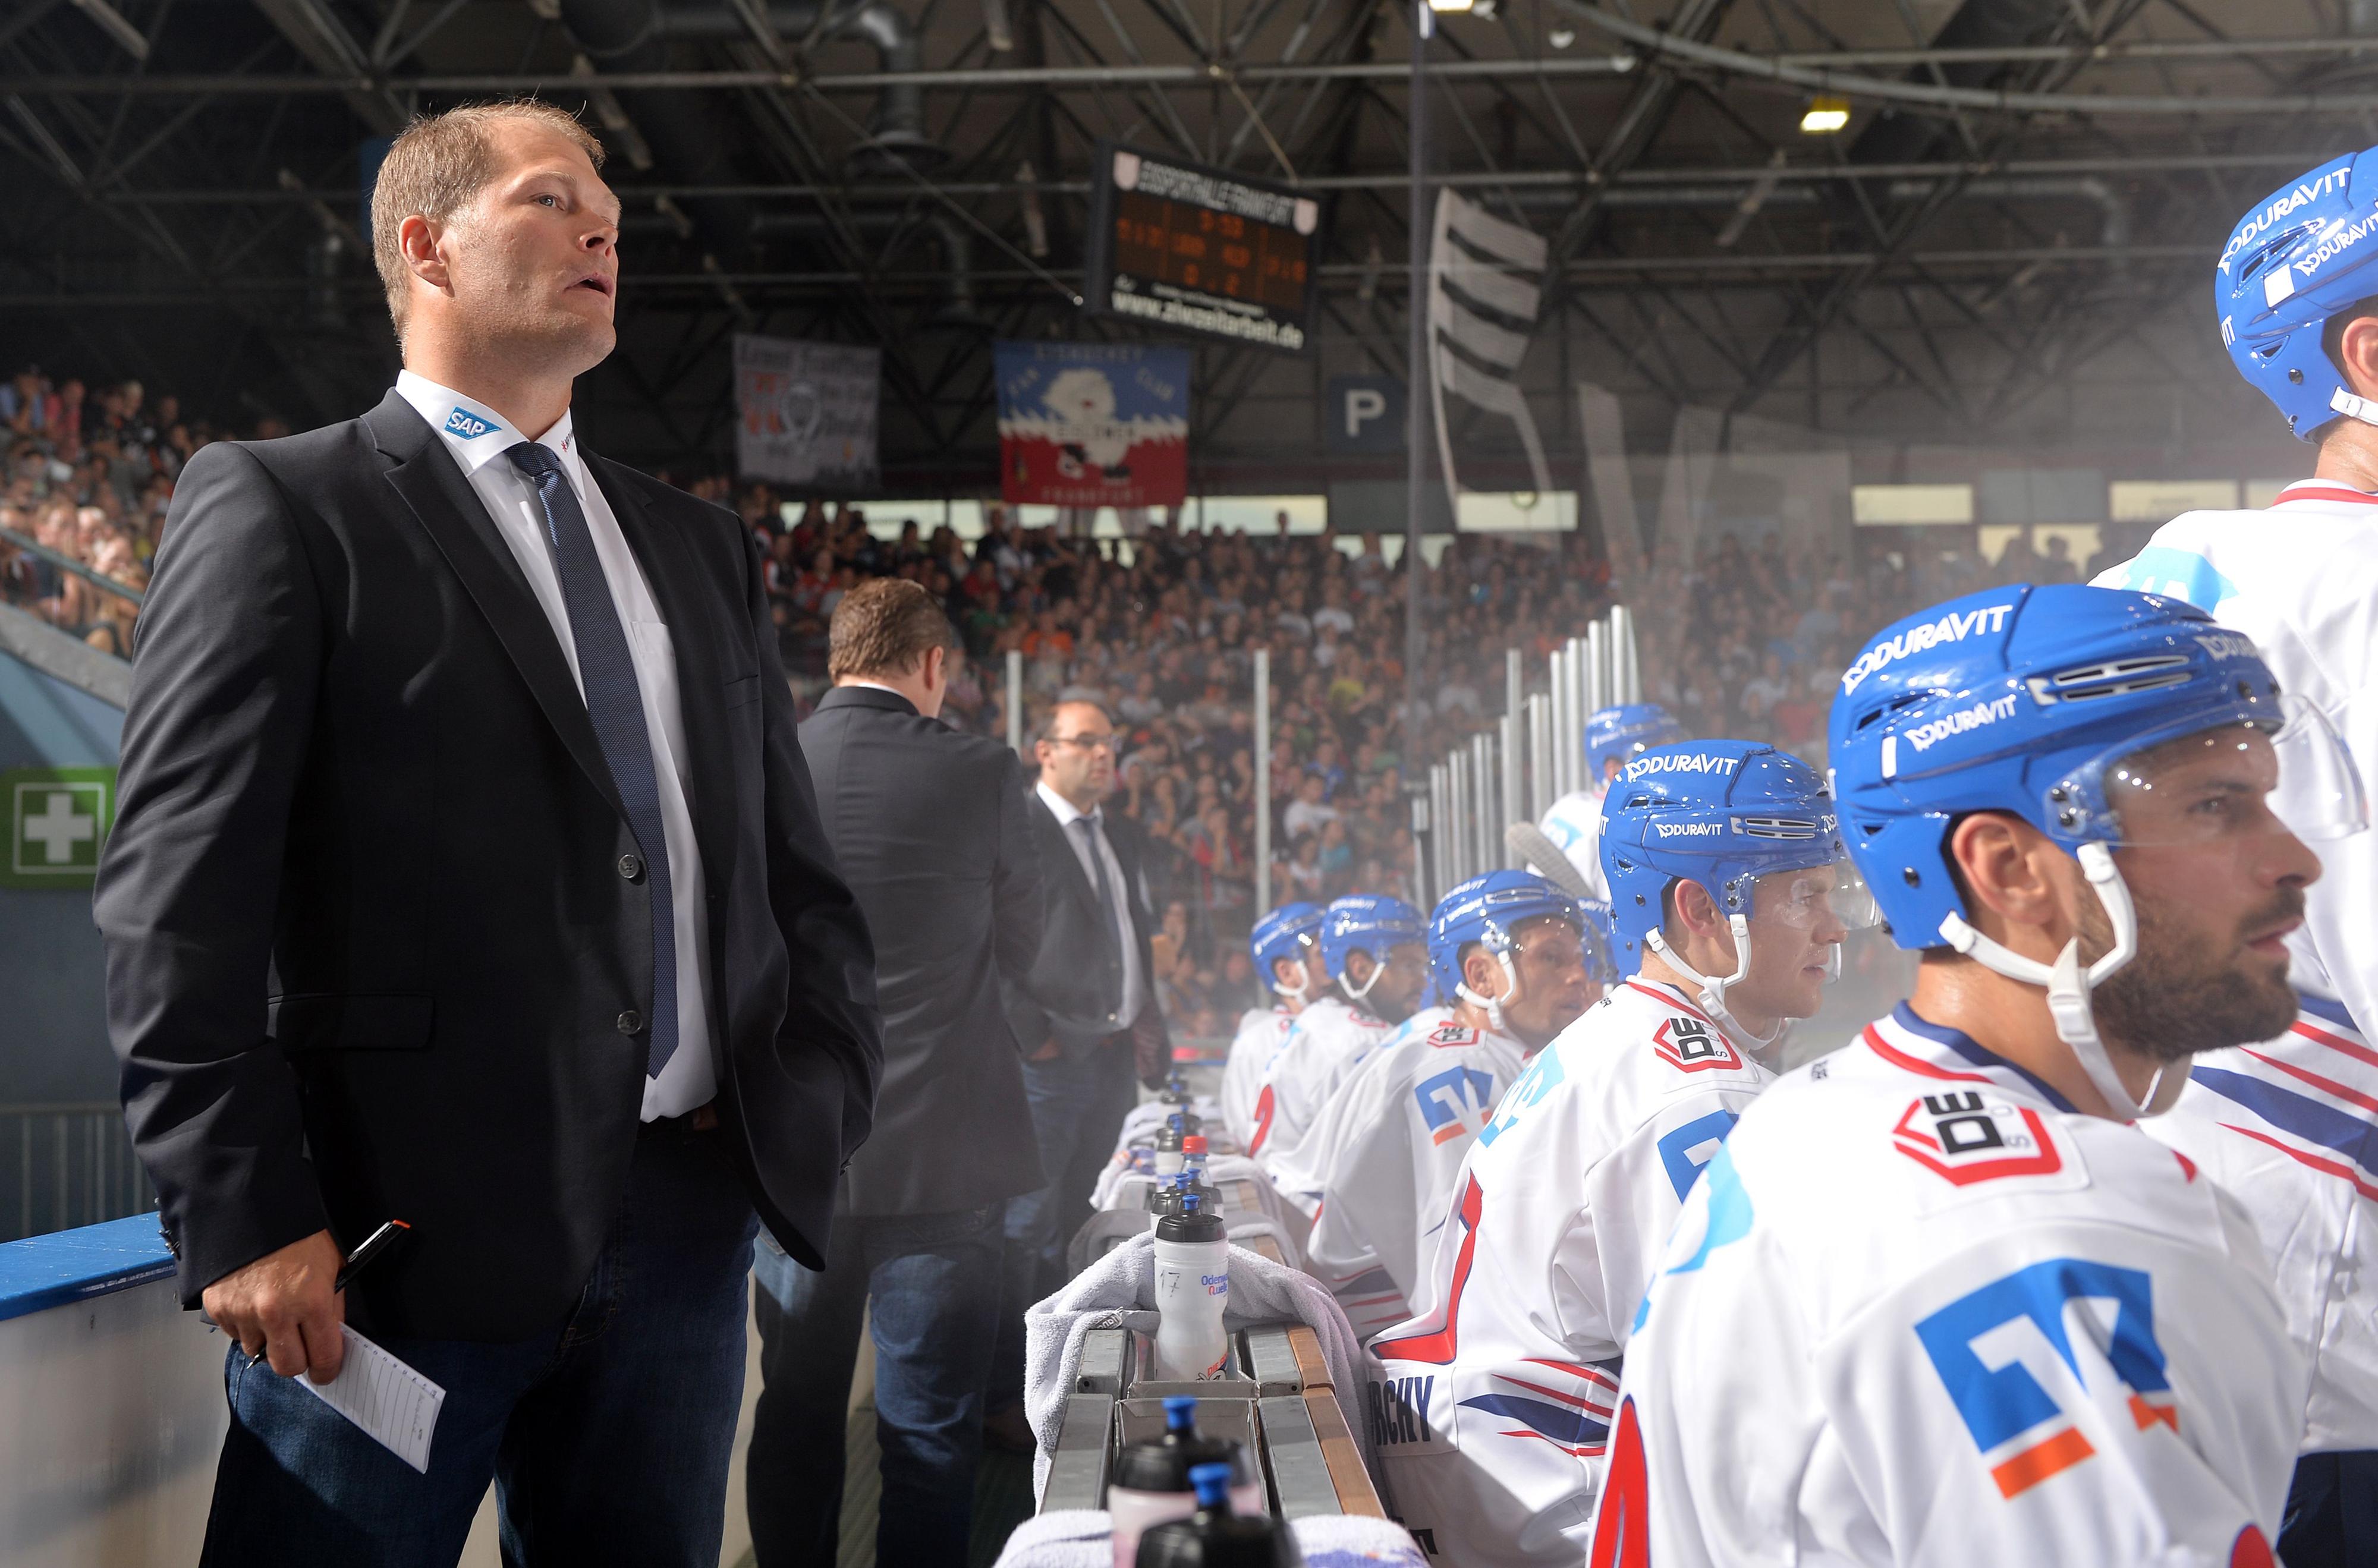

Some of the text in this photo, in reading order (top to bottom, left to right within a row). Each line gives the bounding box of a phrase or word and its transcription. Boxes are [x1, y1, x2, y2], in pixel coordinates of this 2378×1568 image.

[2241, 167, 2351, 247] DURAVIT
[448, 412, 485, 436] SAP
[1345, 389, 1386, 437] P
[1042, 486, 1144, 502] FRANKFURT
[1871, 604, 2013, 672] DURAVIT
[1925, 694, 2017, 743] DURAVIT
[1649, 754, 1738, 776] DURAVIT
[1672, 821, 1723, 837] DURAVIT
